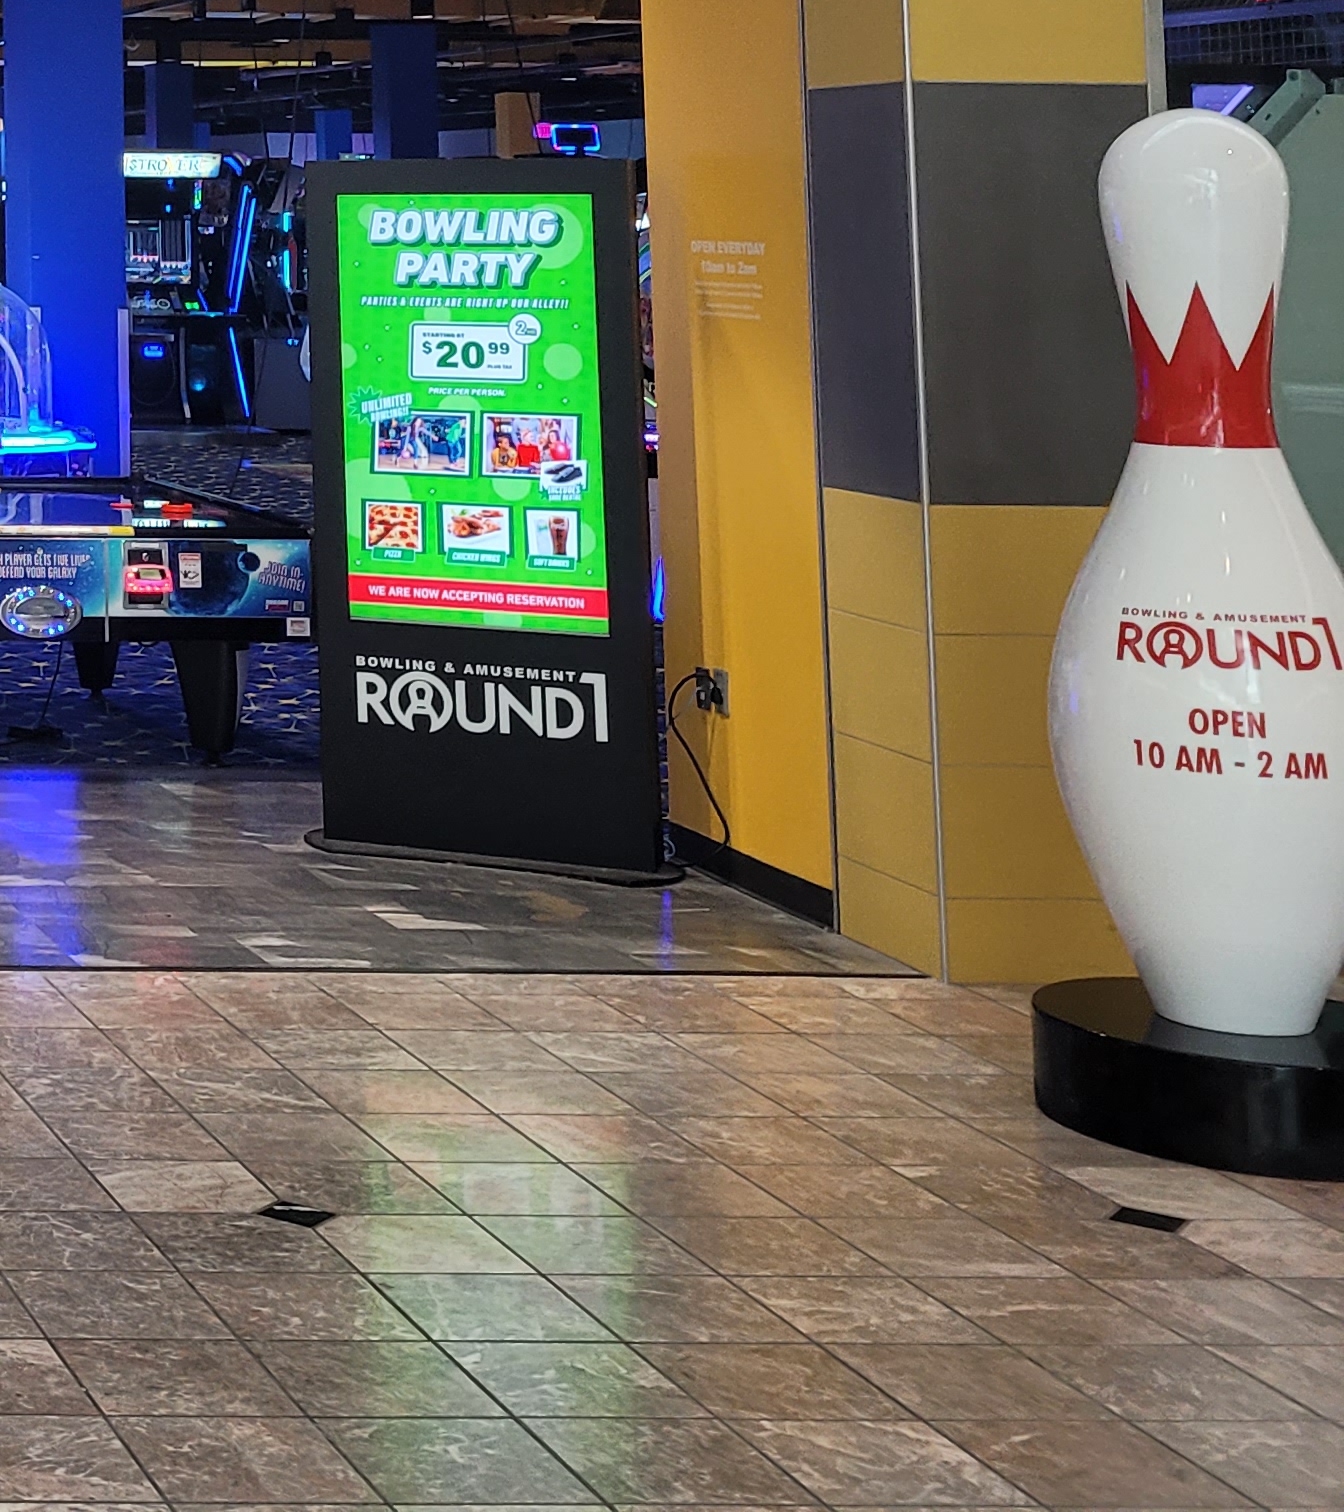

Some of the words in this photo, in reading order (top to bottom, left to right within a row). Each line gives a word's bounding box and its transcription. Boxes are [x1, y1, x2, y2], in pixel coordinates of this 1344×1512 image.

[369, 209, 561, 246] BOWLING
[691, 240, 716, 254] OPEN
[717, 240, 765, 256] EVERYDAY
[395, 251, 536, 287] PARTY
[361, 295, 397, 306] PARTIES
[409, 296, 442, 307] EVENTS
[444, 297, 462, 307] ARE
[466, 297, 493, 307] RIGHT
[496, 298, 508, 307] UP
[511, 298, 529, 308] OUR
[428, 387, 452, 395] PRICE
[454, 388, 470, 396] PER
[361, 392, 412, 414] UNLIMITED
[4, 553, 32, 566] PLAYER
[263, 561, 288, 577] JOIN
[25, 566, 46, 579] YOUR
[47, 566, 77, 579] GALAXY
[258, 572, 306, 593] ANYTIME!
[368, 584, 386, 596] WE
[388, 586, 411, 597] ARE
[413, 587, 439, 599] NOW
[441, 589, 505, 604] ACCEPTING
[507, 593, 585, 609] RESERVATION
[1121, 606, 1188, 620] BOWLING
[1195, 612, 1205, 621] &
[1213, 613, 1307, 624] AMUSEMENT
[1116, 617, 1343, 671] ROUND1
[355, 655, 437, 672] BOWLING
[444, 662, 455, 674] &
[463, 664, 577, 683] AMUSEMENT
[355, 670, 609, 743] ROUND1
[1188, 708, 1267, 739] OPEN
[1133, 739, 1165, 769] 10
[1175, 745, 1223, 775] AM
[1257, 750, 1274, 778] 2
[1284, 752, 1329, 780] AM
